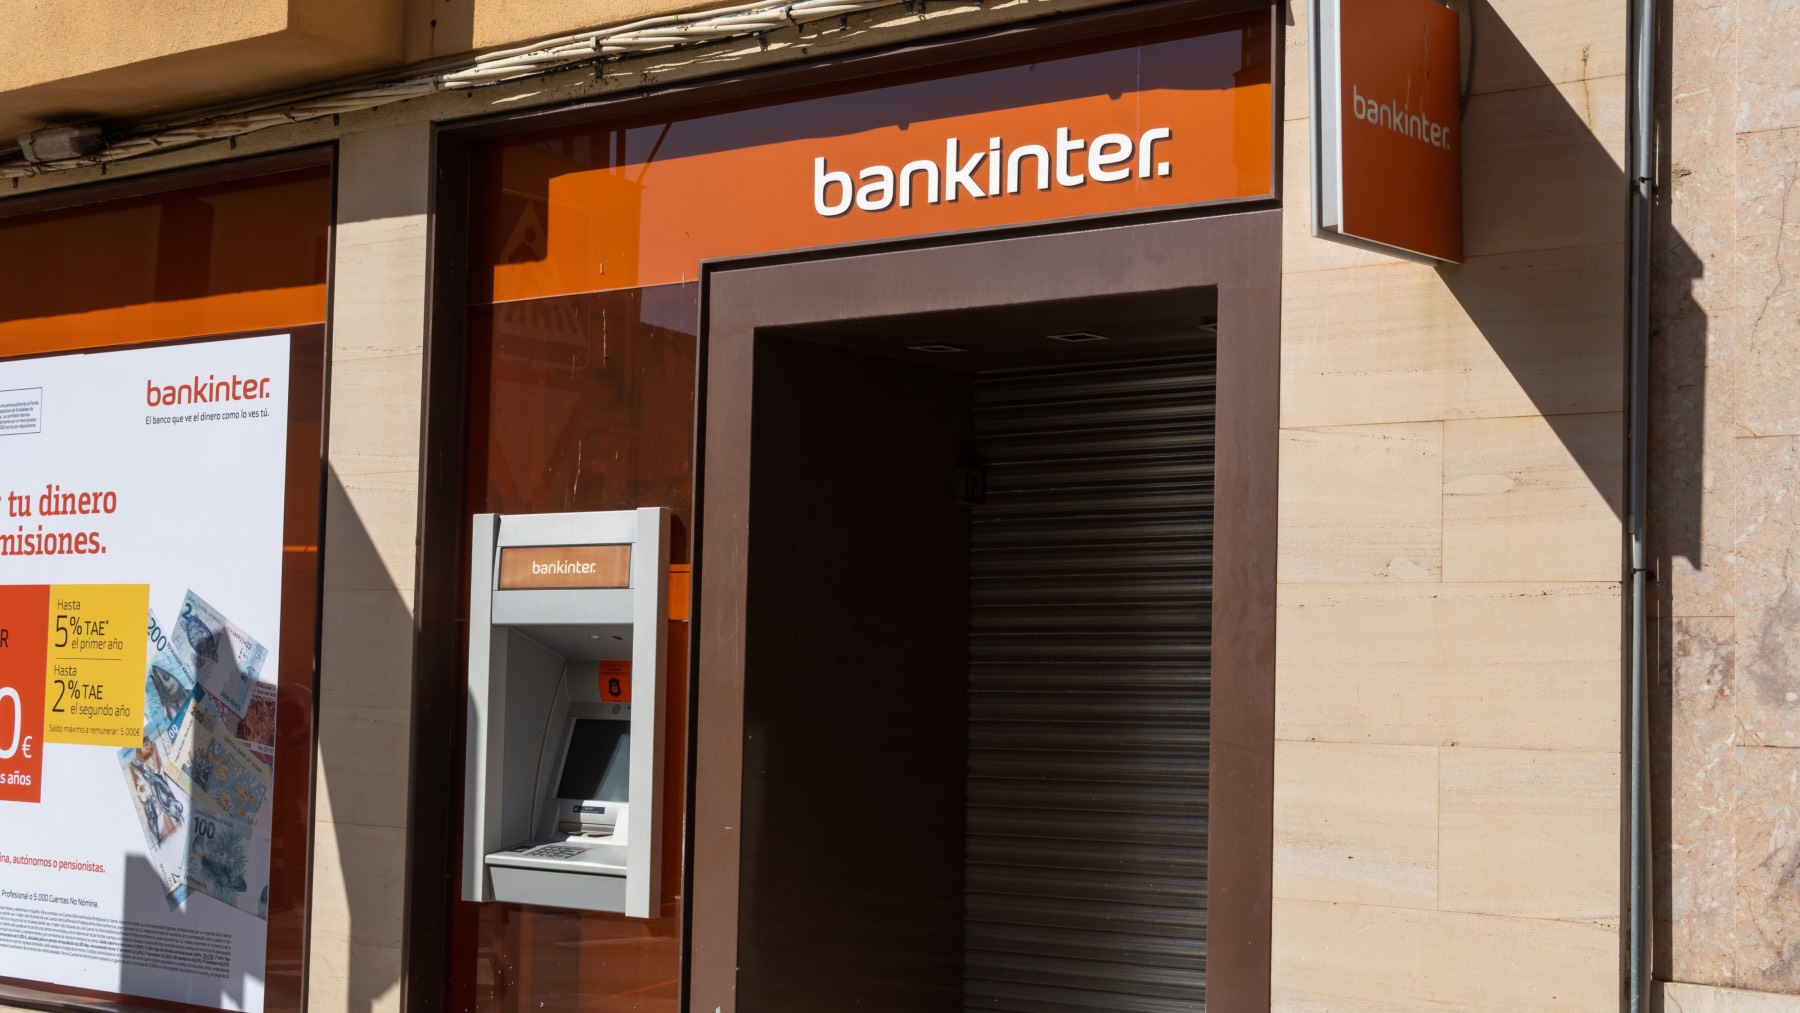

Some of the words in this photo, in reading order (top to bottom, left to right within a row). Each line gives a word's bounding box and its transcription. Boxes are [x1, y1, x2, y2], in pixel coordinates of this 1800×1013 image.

[1353, 83, 1450, 150] bankinter.
[813, 126, 1172, 217] bankinter.
[147, 374, 270, 407] bankinter.
[145, 416, 151, 425] El
[152, 415, 171, 424] banco
[172, 416, 183, 425] que
[193, 412, 199, 422] el
[200, 411, 221, 421] dinero
[221, 412, 240, 420] como
[240, 409, 247, 418] lo
[248, 410, 259, 418] ves
[260, 408, 269, 417] tú.
[8, 490, 31, 517] tu
[39, 484, 117, 516] dinero
[0, 525, 106, 556] misiones.
[532, 560, 596, 574] bankinter.
[57, 598, 80, 610] Hasta
[182, 602, 192, 620] 2
[55, 615, 82, 647] 5%
[148, 617, 167, 651] 200
[71, 637, 78, 649] el
[80, 637, 106, 652] primer
[108, 638, 123, 650] año
[54, 664, 77, 676] Hasta
[52, 680, 80, 712] 2%
[82, 684, 103, 700] TAE
[70, 702, 78, 714] el
[79, 704, 113, 718] segundo
[114, 705, 130, 717] año
[49, 723, 63, 732] Saldo
[64, 725, 84, 733] máximo
[7, 770, 31, 785] años
[194, 816, 216, 840] 100
[12, 854, 51, 868] autónomos
[53, 860, 57, 868] o
[59, 859, 105, 873] pensionistas.
[2, 889, 29, 899] Profesional
[33, 893, 48, 902] 5.000
[49, 895, 69, 904] Cuentas
[78, 898, 99, 908] Nómina.
